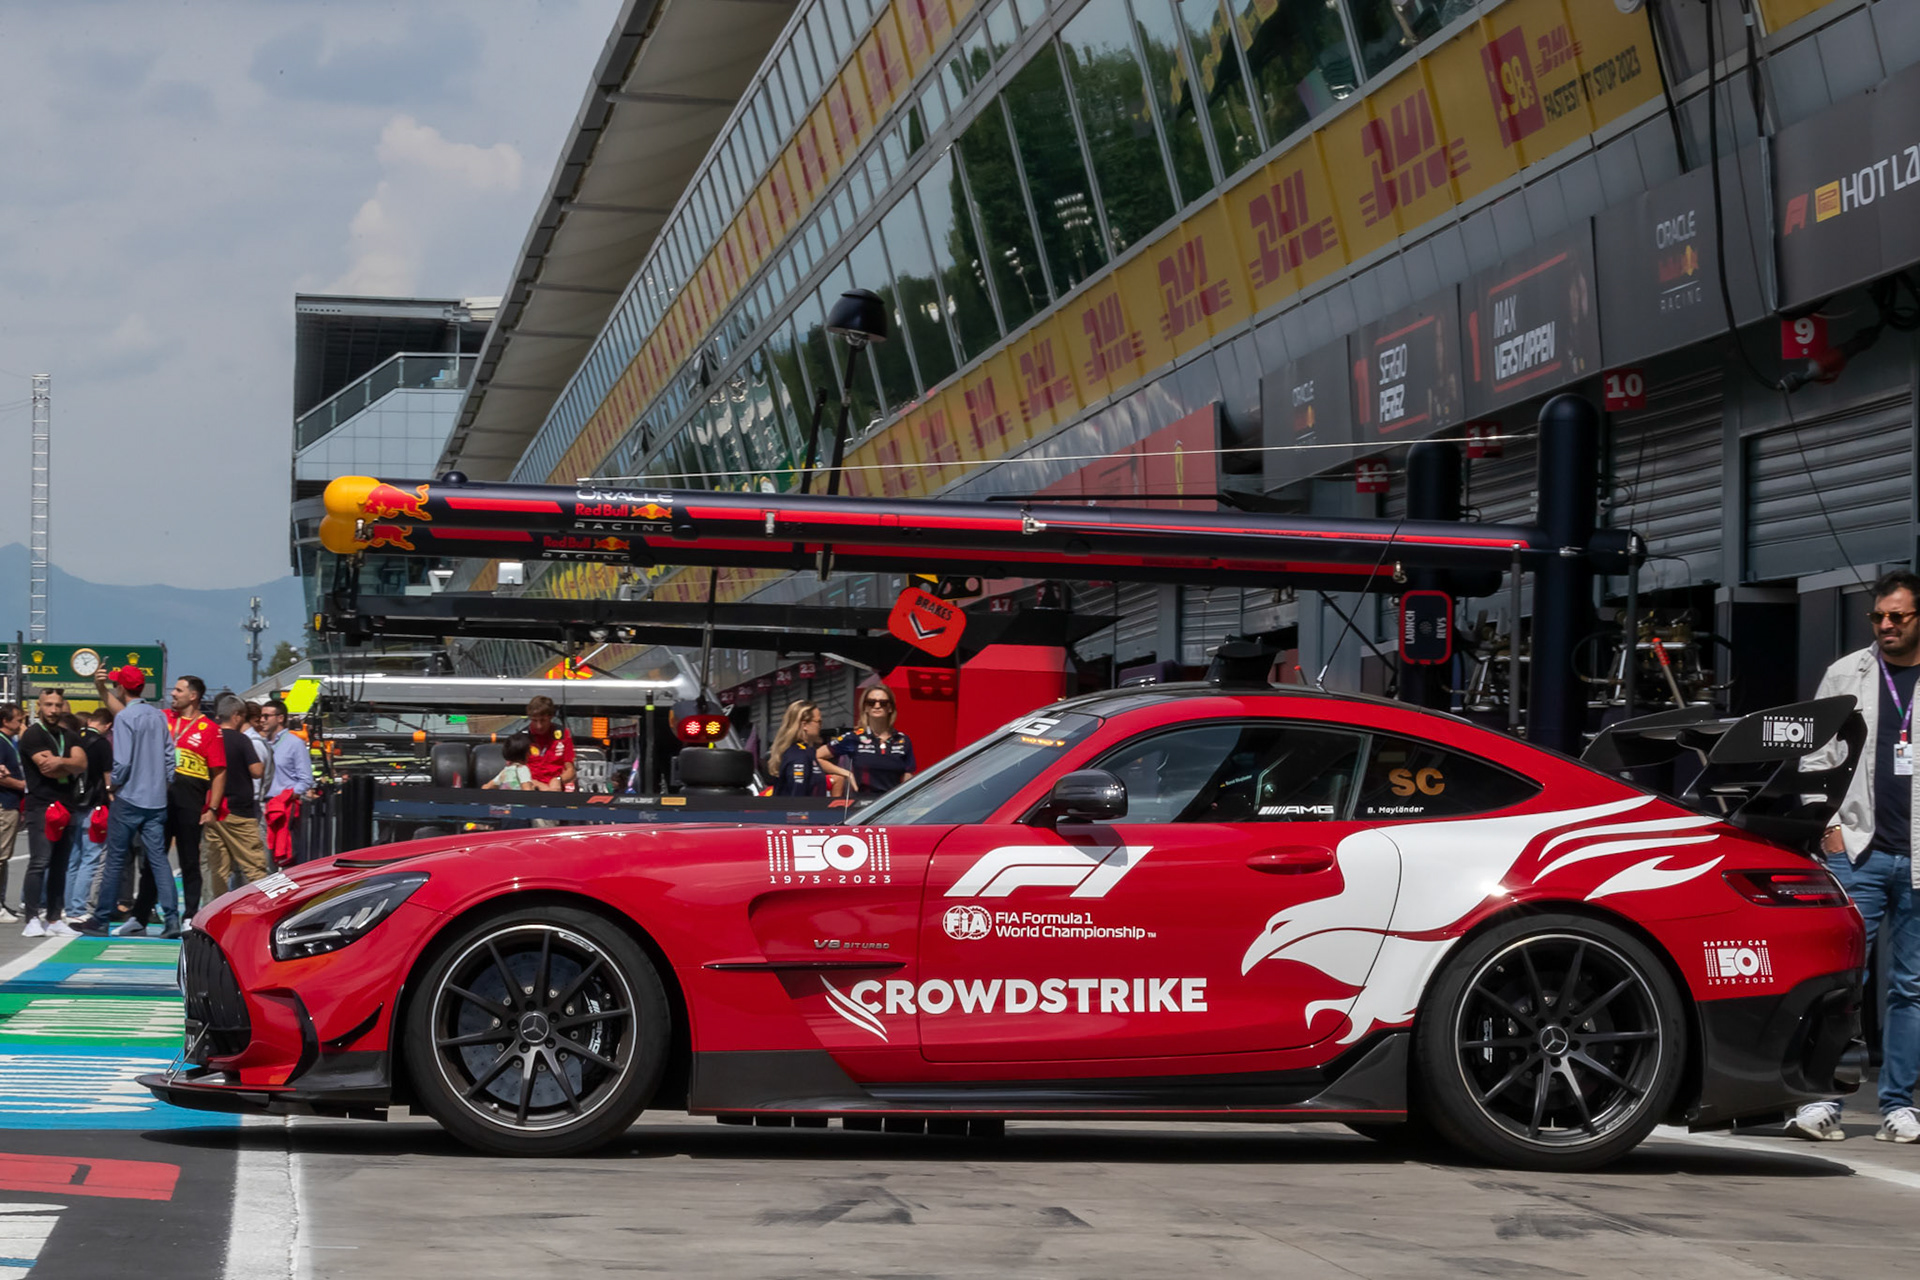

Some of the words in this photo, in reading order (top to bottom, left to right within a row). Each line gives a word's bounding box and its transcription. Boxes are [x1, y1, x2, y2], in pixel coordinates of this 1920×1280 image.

[1593, 58, 1616, 96] STOP
[1359, 88, 1471, 227] DHL
[1841, 159, 1889, 212] HOT
[1249, 169, 1337, 290] DHL
[1656, 210, 1696, 249] ORACLE
[1158, 235, 1232, 342] DHL
[1494, 295, 1517, 339] MAX
[1082, 292, 1146, 385] DHL
[1794, 318, 1815, 344] 9
[1494, 321, 1555, 380] VERSTAPPEN
[1379, 344, 1408, 385] SERGIO
[1020, 337, 1074, 420] DHL
[1606, 373, 1643, 398] 10
[1379, 384, 1405, 423] PEREZ
[1468, 425, 1498, 448] 11
[1358, 463, 1388, 484] 12
[576, 489, 673, 503] ORACLE
[575, 503, 601, 516] Red
[602, 503, 628, 517] Bull
[574, 522, 673, 532] RACING
[543, 536, 567, 548] Red
[569, 536, 591, 549] Bull
[542, 552, 630, 561] RACING
[915, 595, 953, 621] BRAKES
[1405, 610, 1415, 644] LAUNCH
[25, 665, 58, 675] OLEX
[800, 664, 815, 674] 23
[1773, 721, 1804, 742] 50
[1388, 767, 1446, 797] SC
[1283, 805, 1334, 814] AMG
[1378, 806, 1424, 815] Mayländer
[792, 834, 869, 872] 50
[770, 875, 891, 884] 1973-2023
[943, 845, 1154, 898] F1
[995, 912, 1020, 924] FIA
[1022, 912, 1082, 925] Formula
[1084, 912, 1093, 924] 1
[814, 939, 840, 949] V8
[995, 925, 1039, 938] World
[1041, 925, 1145, 940] Championship
[1717, 947, 1759, 977] 50
[850, 978, 1208, 1015] CROWDSTRIKE
